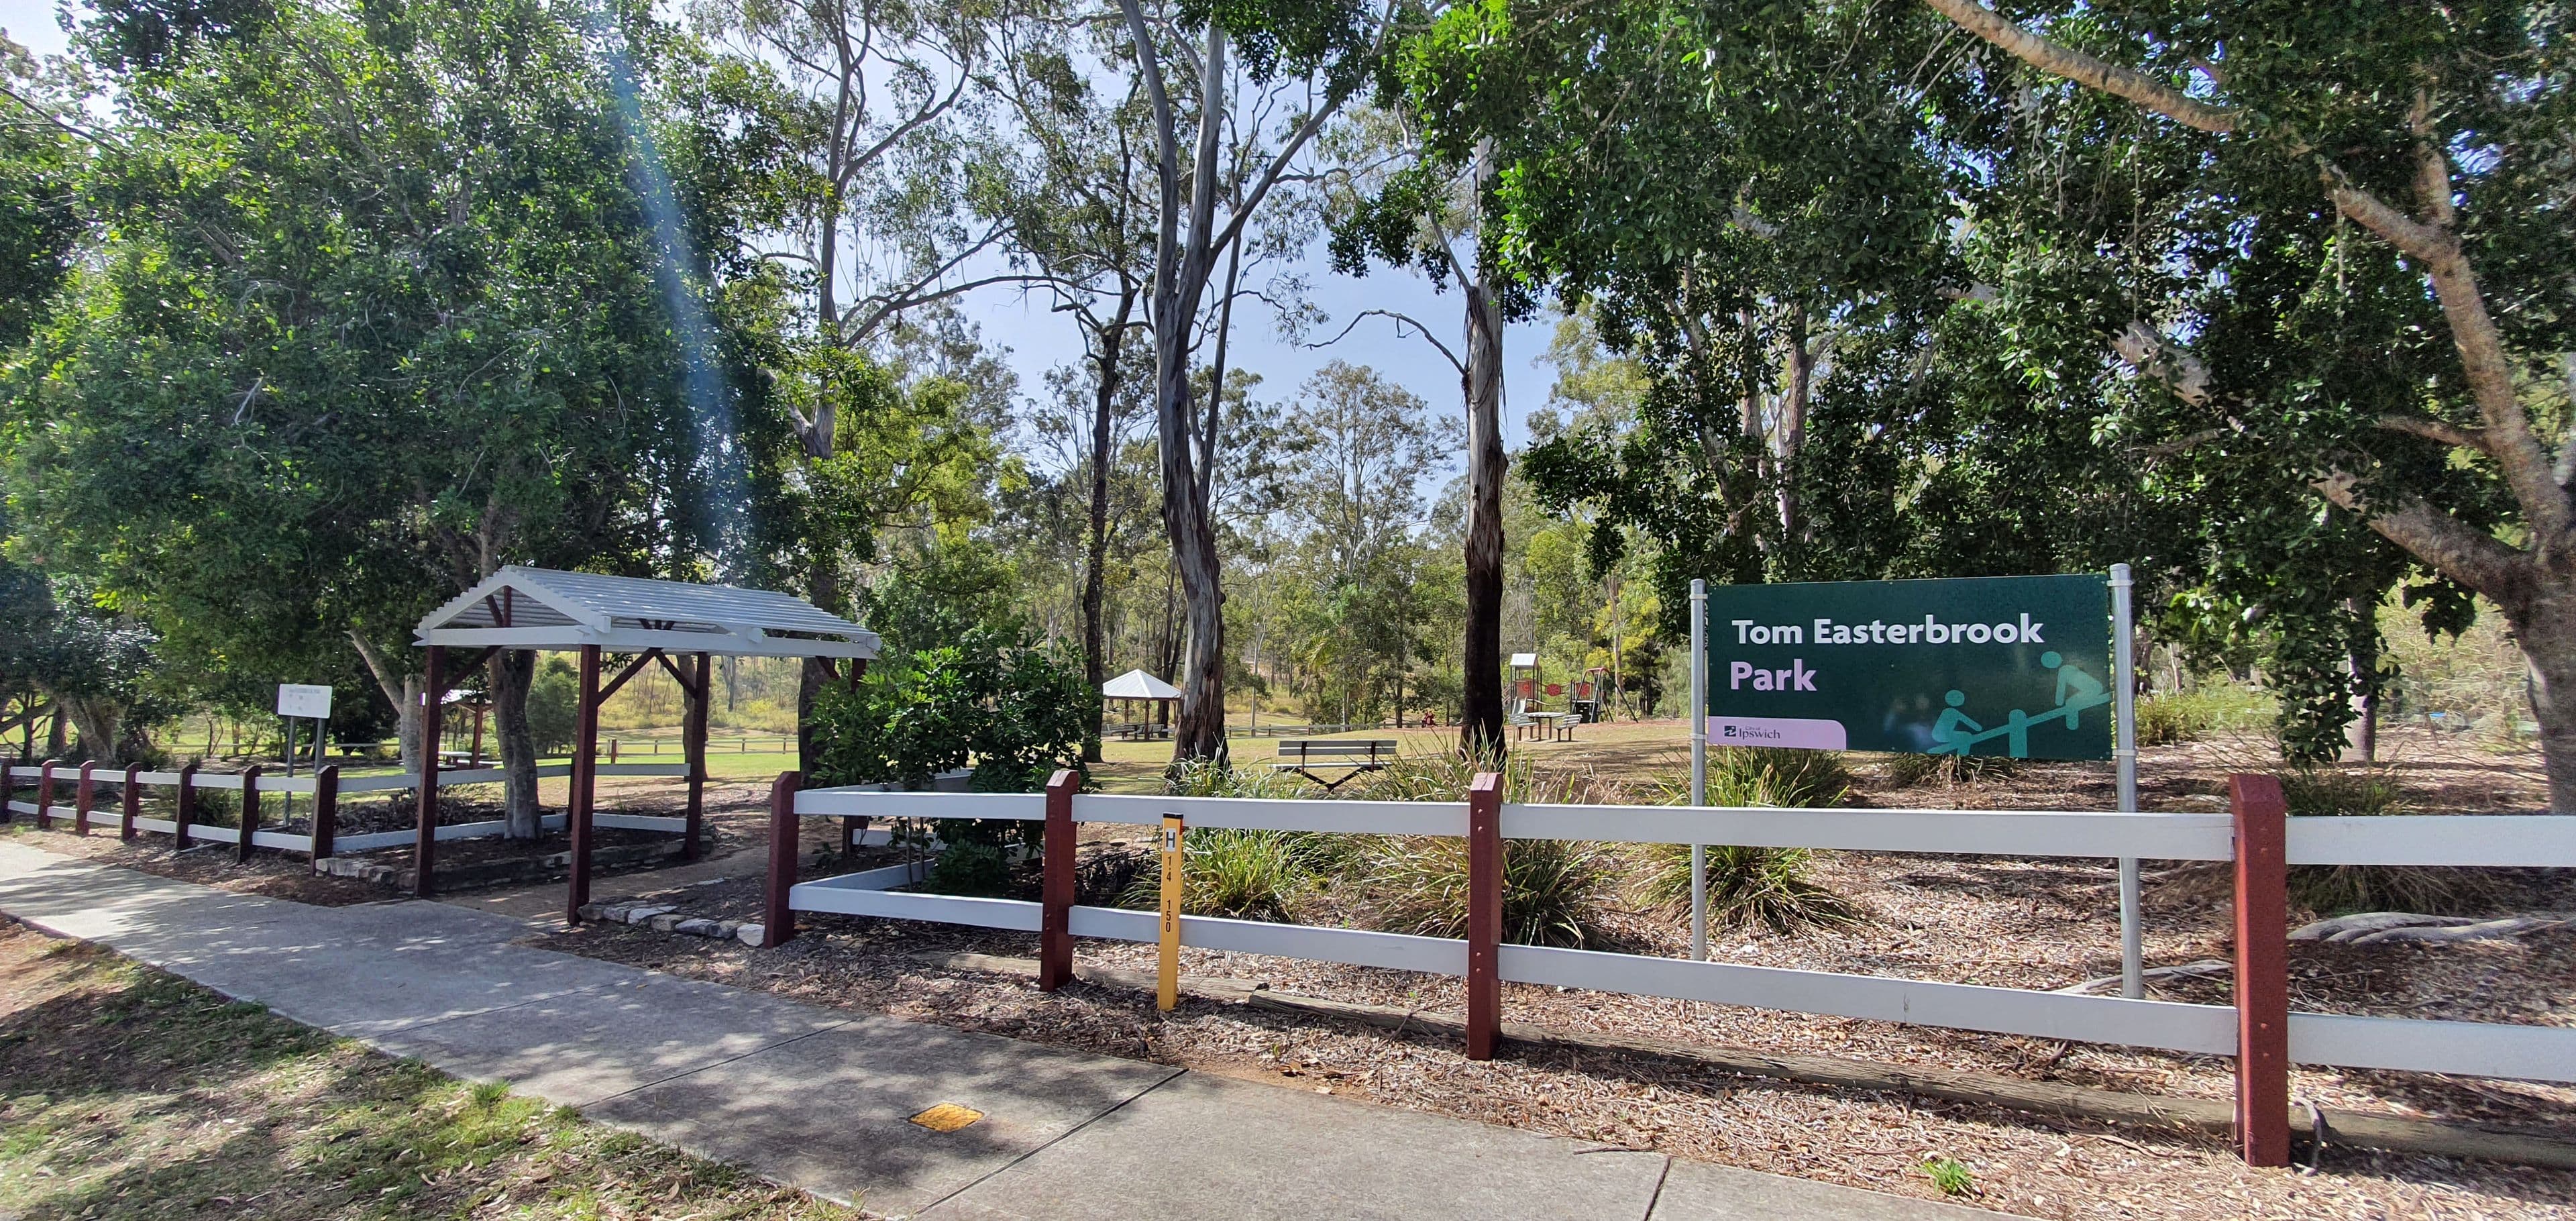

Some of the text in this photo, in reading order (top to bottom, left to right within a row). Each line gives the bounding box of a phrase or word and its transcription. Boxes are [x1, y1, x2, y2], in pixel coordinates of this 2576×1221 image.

[1731, 613, 2045, 645] Tom Easterbrook
[1730, 659, 1818, 692] Park
[1739, 728, 1780, 740] Ipswich
[1165, 831, 1176, 849] H
